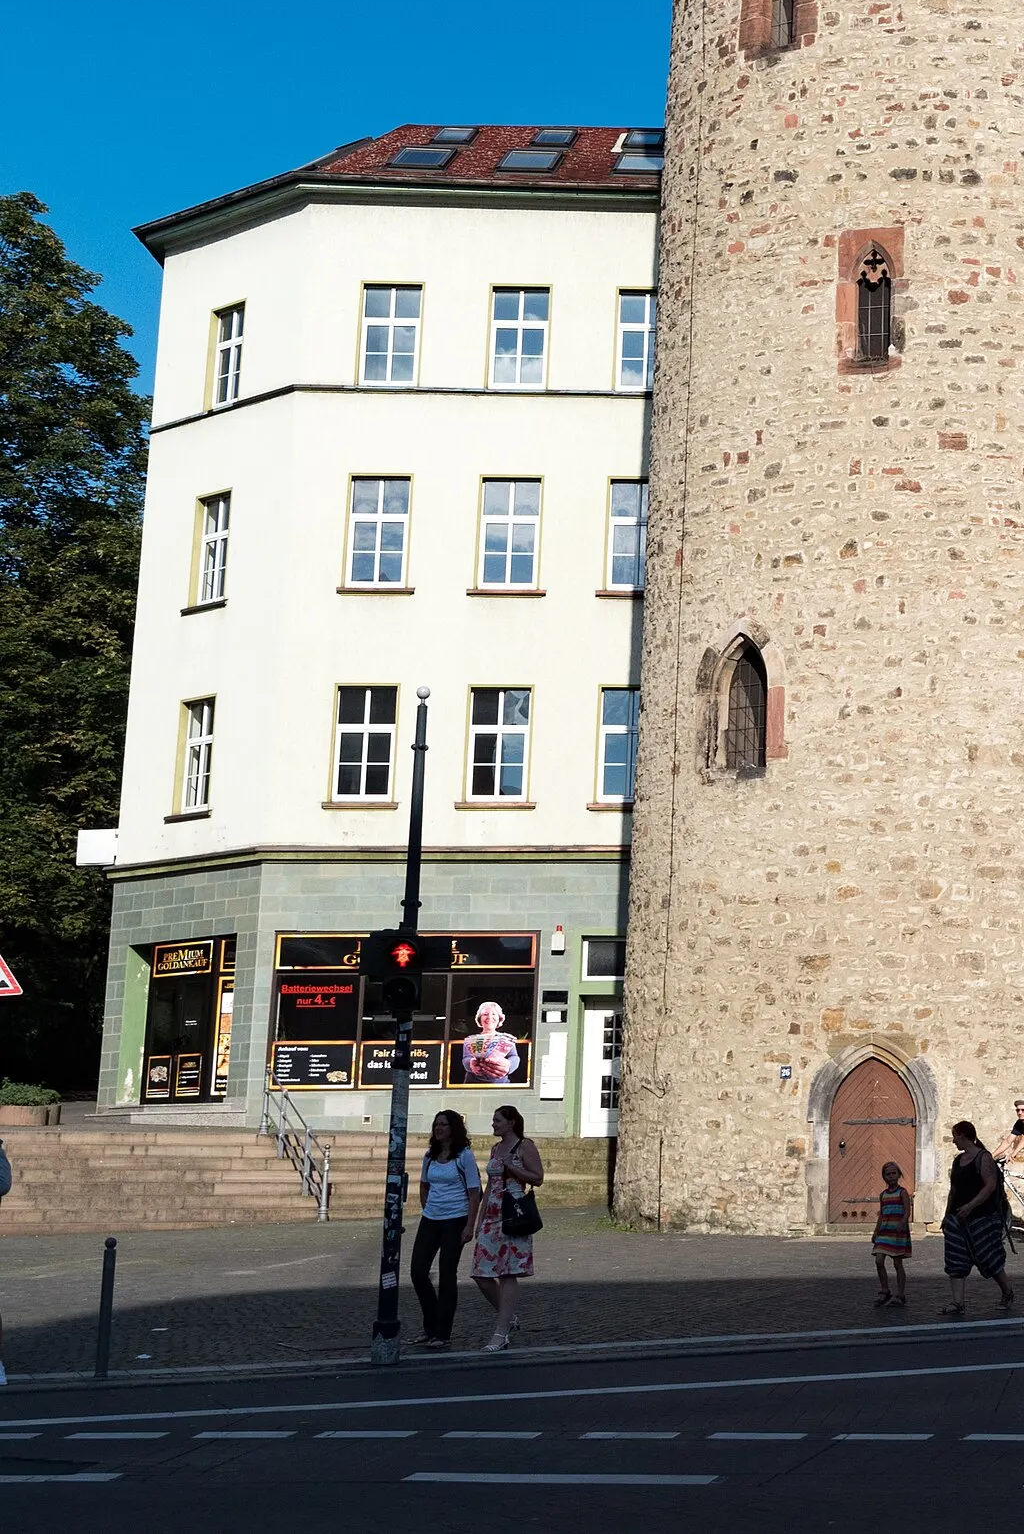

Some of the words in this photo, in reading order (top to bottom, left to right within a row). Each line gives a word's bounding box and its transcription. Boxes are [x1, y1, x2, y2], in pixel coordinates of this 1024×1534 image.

[163, 949, 204, 961] PREMIUM
[158, 958, 208, 971] GOLDANKAUF
[281, 984, 353, 993] Batteriewechsel
[330, 997, 336, 1005] €
[373, 1049, 390, 1058] Fair
[367, 1060, 383, 1069] das
[781, 1068, 791, 1077] 26
